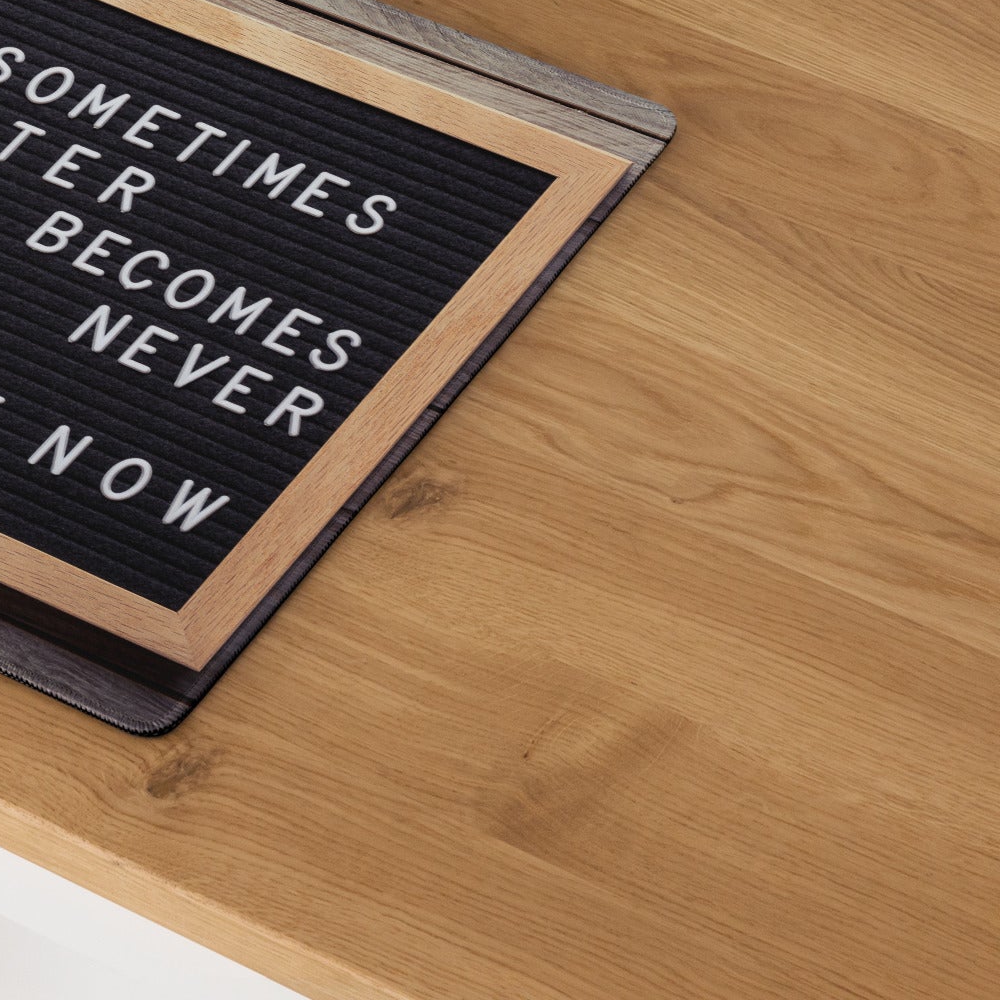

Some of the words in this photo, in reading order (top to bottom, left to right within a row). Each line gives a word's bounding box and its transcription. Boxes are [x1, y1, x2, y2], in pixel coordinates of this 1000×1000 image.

[25, 210, 362, 371] BECOMES
[67, 304, 324, 437] NEVER
[27, 424, 231, 532] NOW
